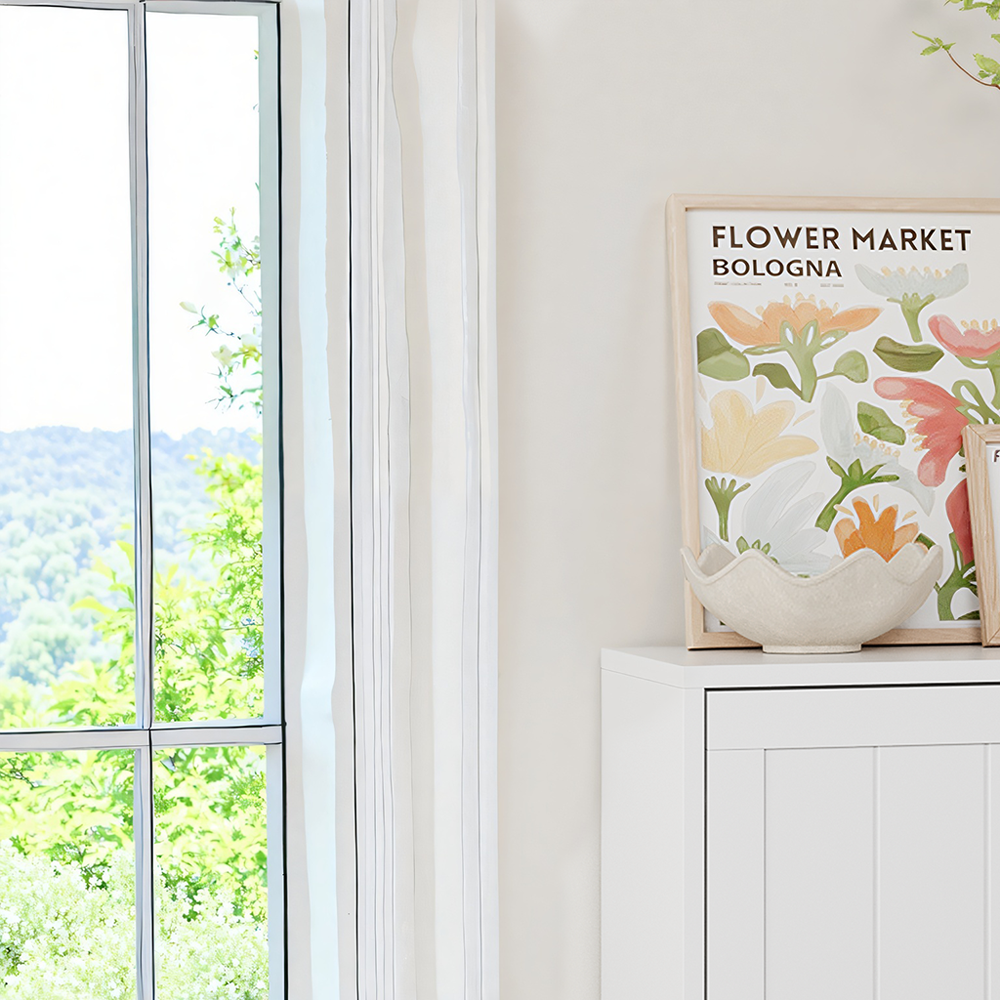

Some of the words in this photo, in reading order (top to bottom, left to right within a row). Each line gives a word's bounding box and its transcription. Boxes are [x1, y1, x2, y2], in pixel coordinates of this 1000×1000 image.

[712, 225, 841, 250] FLOWER
[851, 227, 972, 251] MARKET
[712, 258, 843, 278] BOLOGNA
